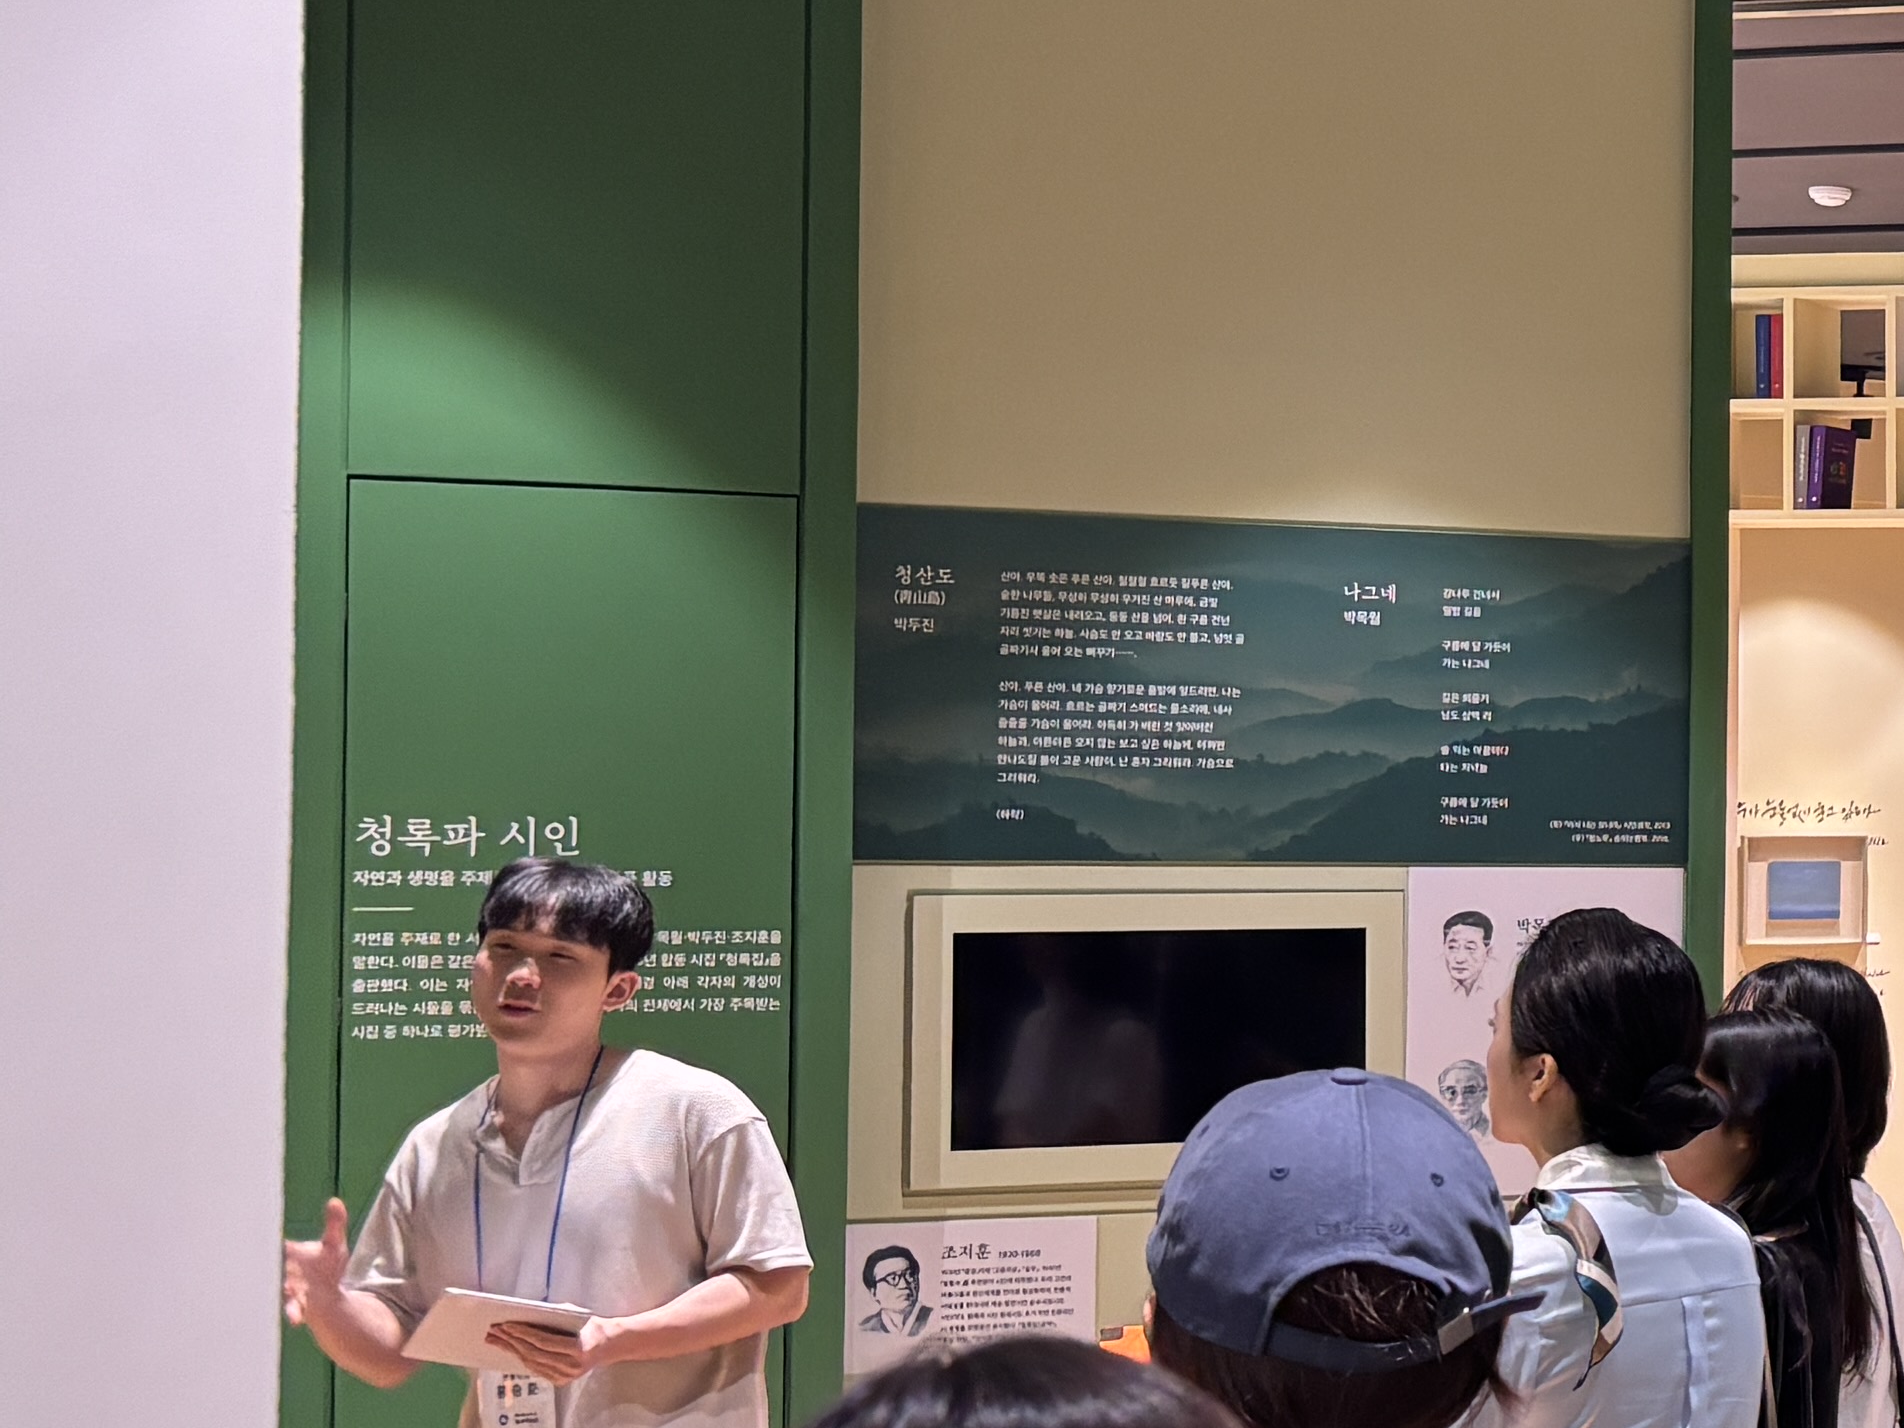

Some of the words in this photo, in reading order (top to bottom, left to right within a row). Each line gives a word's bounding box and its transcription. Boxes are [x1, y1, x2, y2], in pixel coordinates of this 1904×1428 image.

[895, 564, 955, 586] 청산도
[1344, 582, 1398, 603] 나그네
[894, 617, 935, 633] 박두진
[1344, 611, 1381, 626] 박목월
[356, 815, 486, 858] 청록파
[500, 816, 581, 857] 시인
[352, 870, 402, 886] 자연과
[408, 869, 454, 886] 생명을
[642, 870, 673, 887] 활동
[942, 1243, 991, 1260] 조지훈
